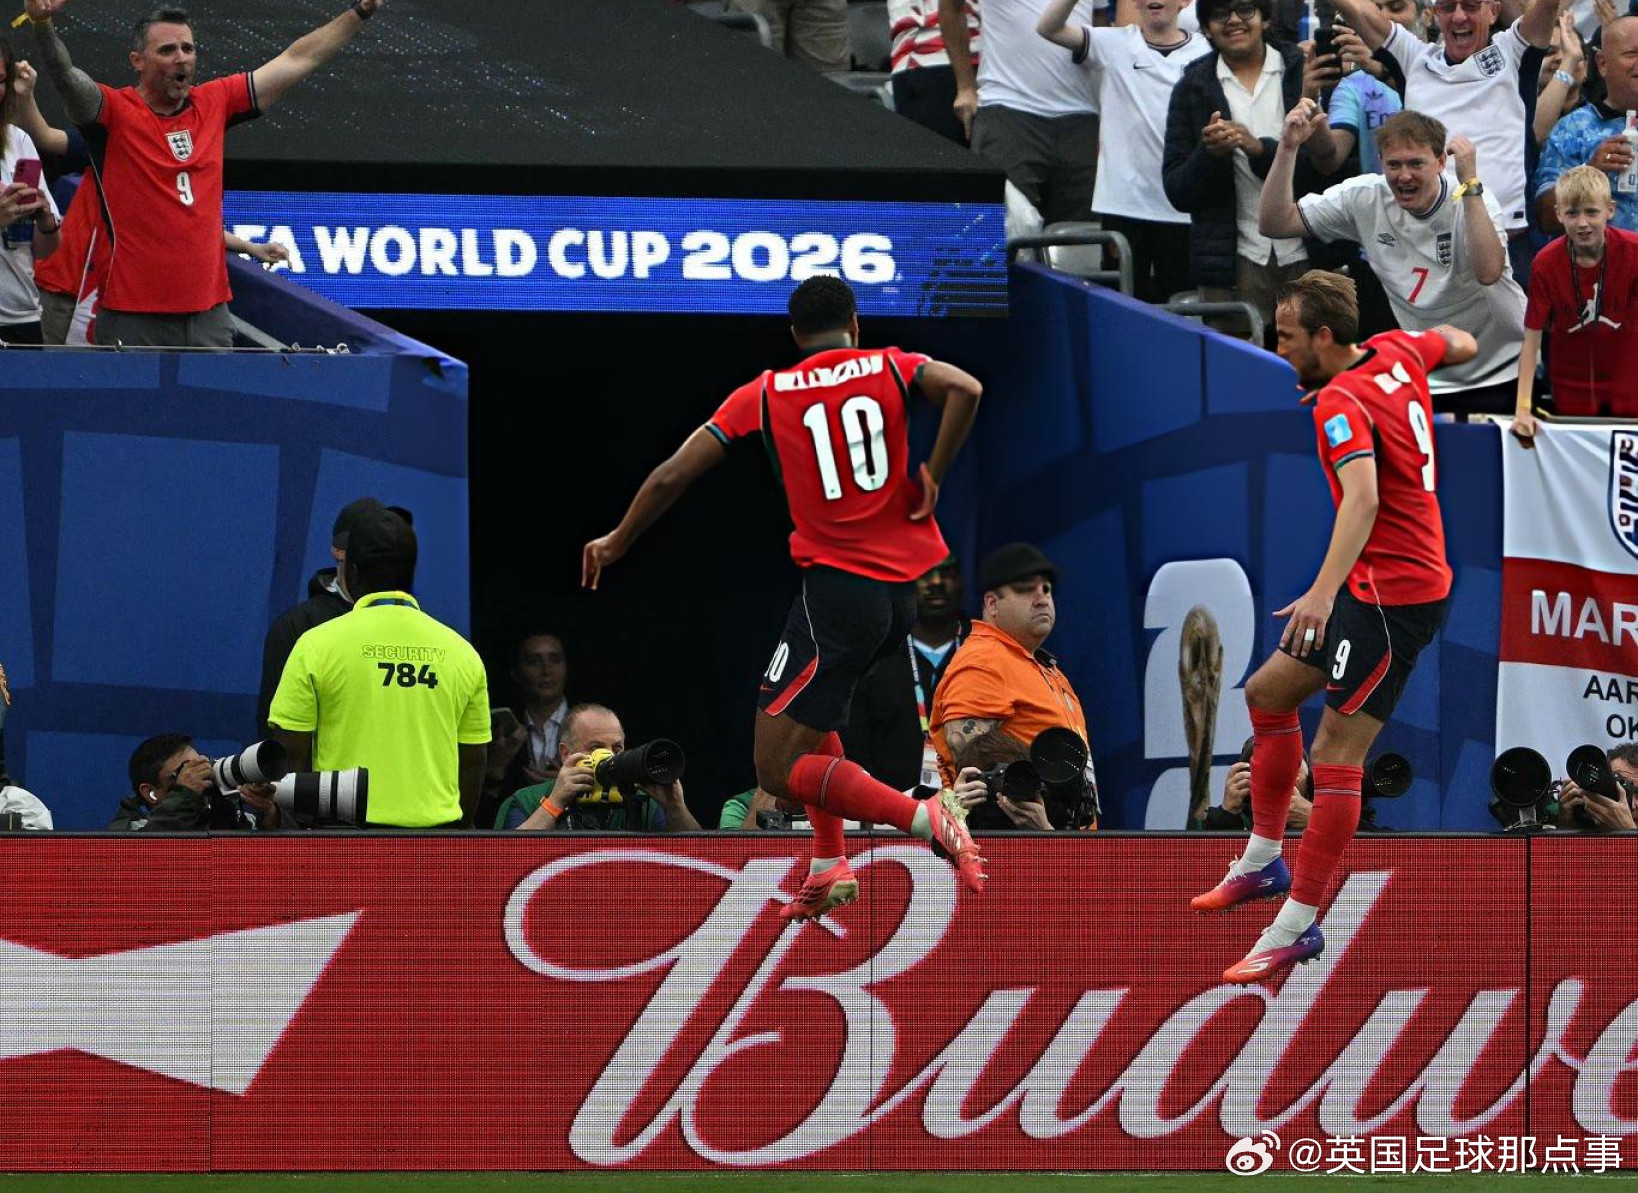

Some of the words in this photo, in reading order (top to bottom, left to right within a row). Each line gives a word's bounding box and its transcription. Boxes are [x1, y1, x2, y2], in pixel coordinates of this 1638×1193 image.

[176, 171, 194, 206] 9
[313, 225, 538, 277] WORLD
[548, 228, 671, 279] CUP
[681, 230, 896, 284] 2026
[1407, 266, 1429, 304] 7
[803, 395, 889, 500] 10
[1408, 400, 1435, 492] 9
[362, 644, 446, 663] SECURITY
[1332, 639, 1352, 680] 9
[377, 662, 439, 689] 784
